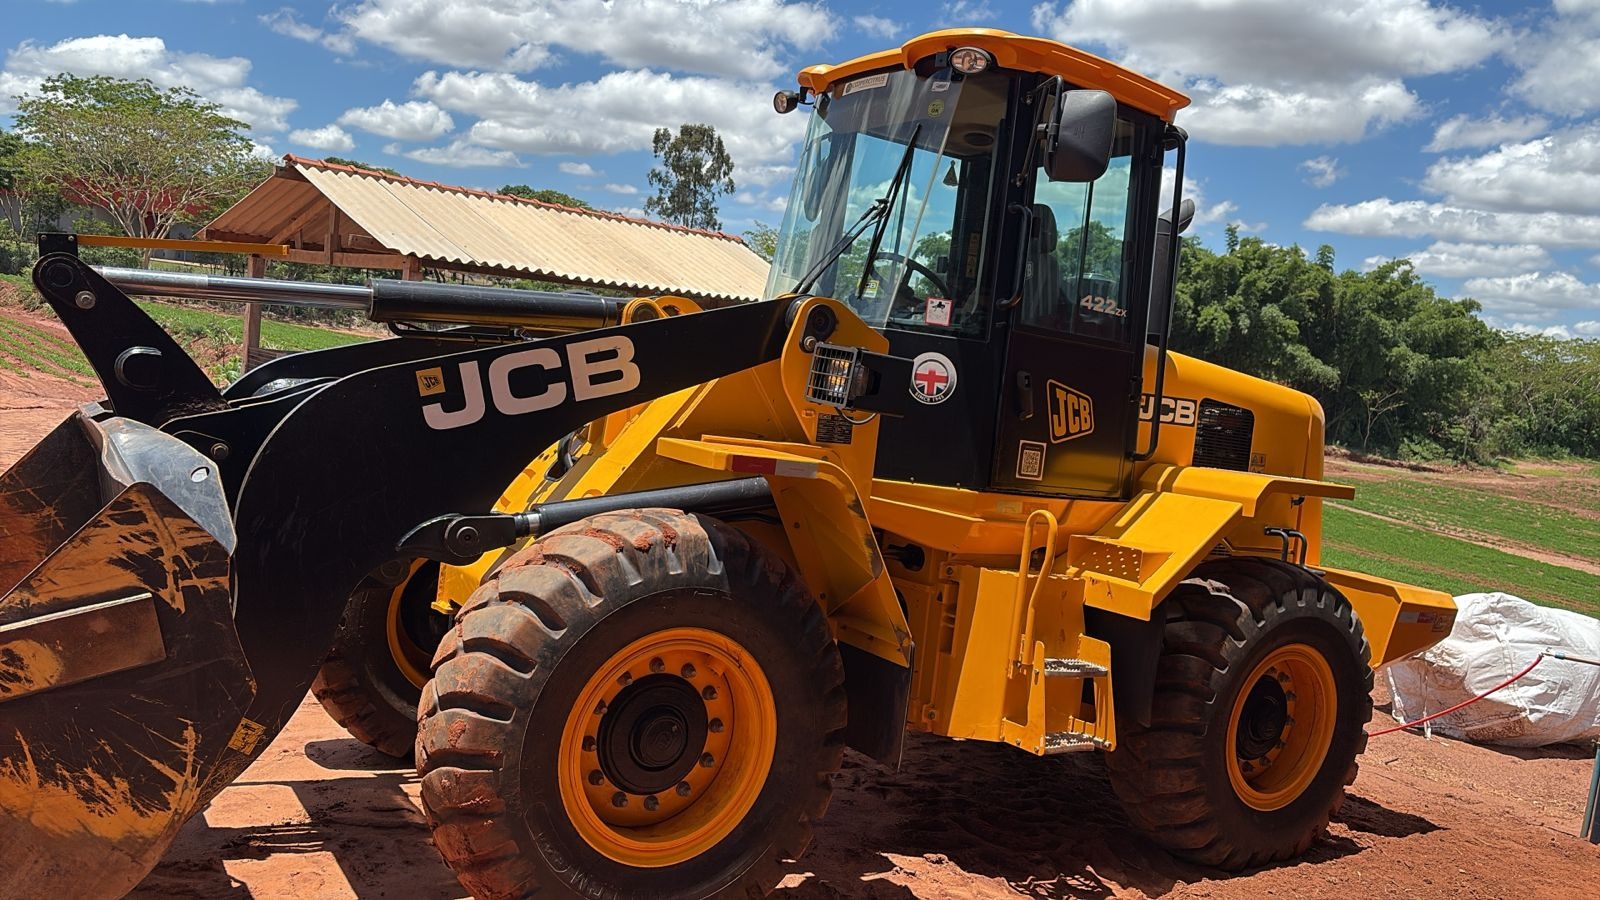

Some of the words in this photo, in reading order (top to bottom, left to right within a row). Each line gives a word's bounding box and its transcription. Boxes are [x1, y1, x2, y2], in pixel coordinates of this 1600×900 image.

[422, 335, 641, 430] JCB
[423, 375, 440, 389] JCB
[1052, 387, 1092, 437] JCB
[1139, 395, 1196, 425] JCB
